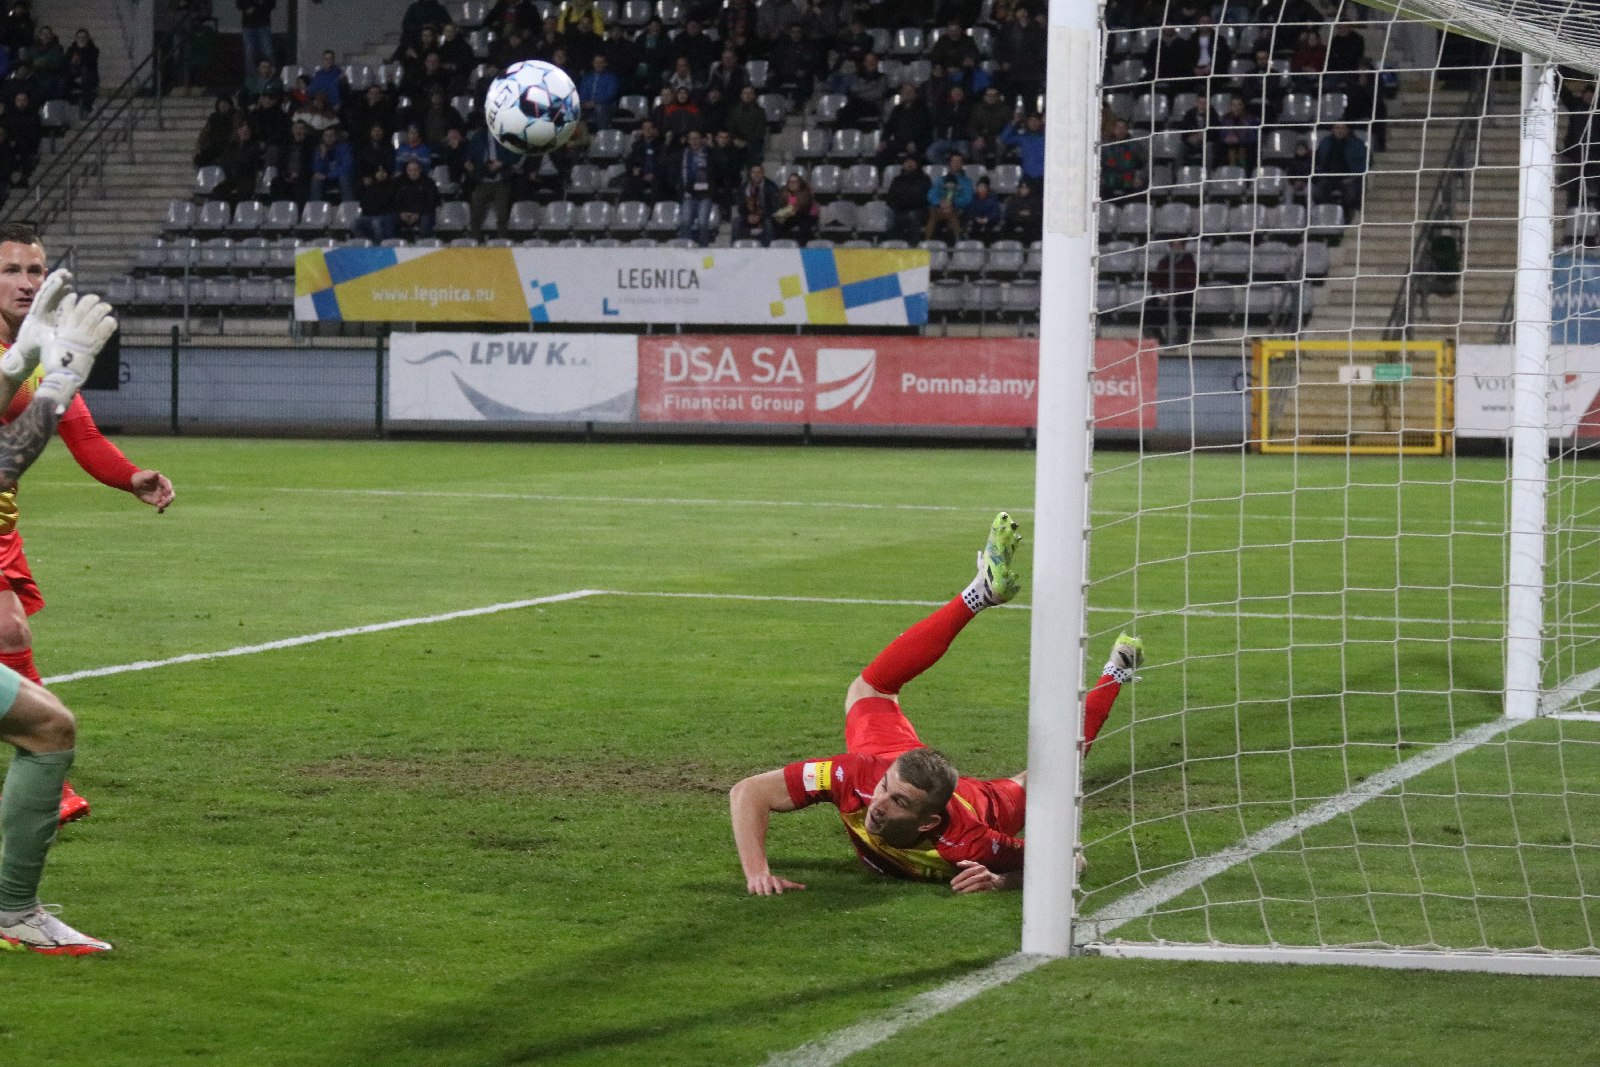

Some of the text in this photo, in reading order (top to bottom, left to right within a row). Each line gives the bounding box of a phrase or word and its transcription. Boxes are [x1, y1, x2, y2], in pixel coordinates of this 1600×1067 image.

[618, 268, 700, 290] LEGNICA
[372, 285, 495, 307] www.legnica.eu
[663, 347, 804, 384] DSA SA
[901, 373, 1137, 399] Pomnażamy ości
[664, 394, 804, 413] Financial Group
